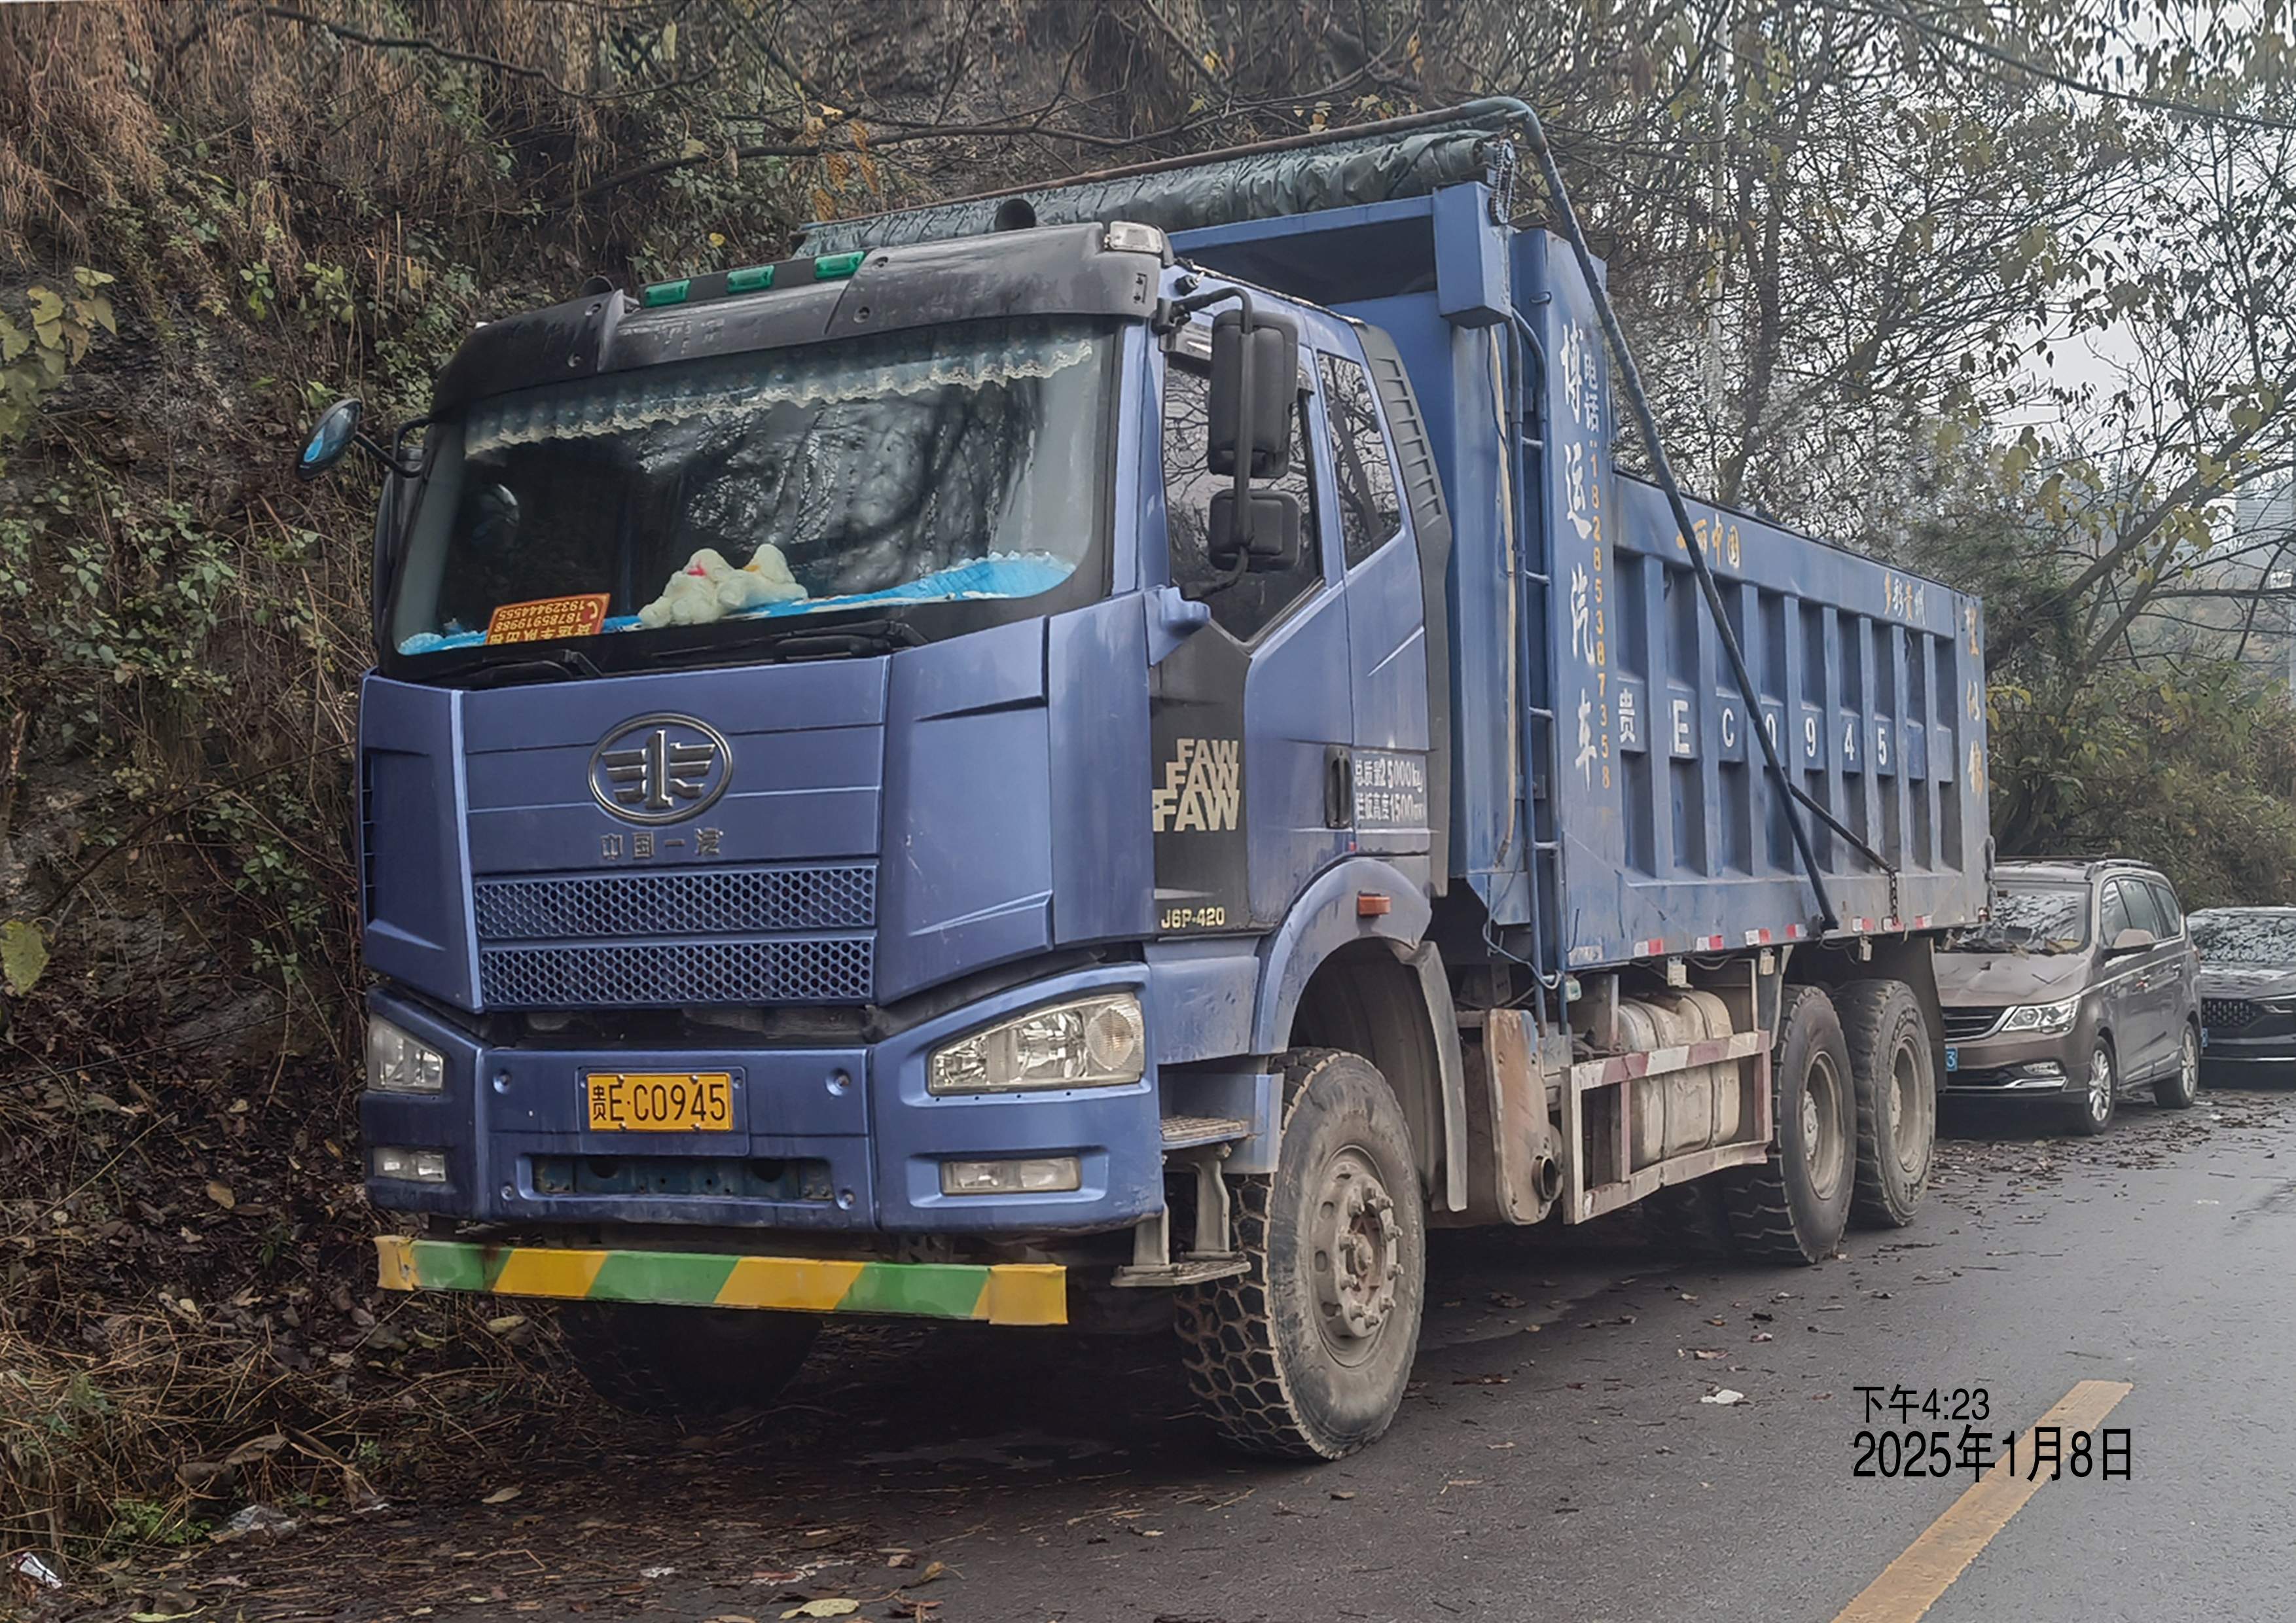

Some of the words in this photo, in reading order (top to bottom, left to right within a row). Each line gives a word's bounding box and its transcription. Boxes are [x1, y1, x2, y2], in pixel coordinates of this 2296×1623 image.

[1676, 513, 1740, 569] 丽中国
[499, 600, 585, 620] 19329444555
[1177, 738, 1238, 767] FAW
[1166, 762, 1239, 796] FAW
[1152, 789, 1240, 832] FAW
[600, 827, 724, 860] 中国一汽
